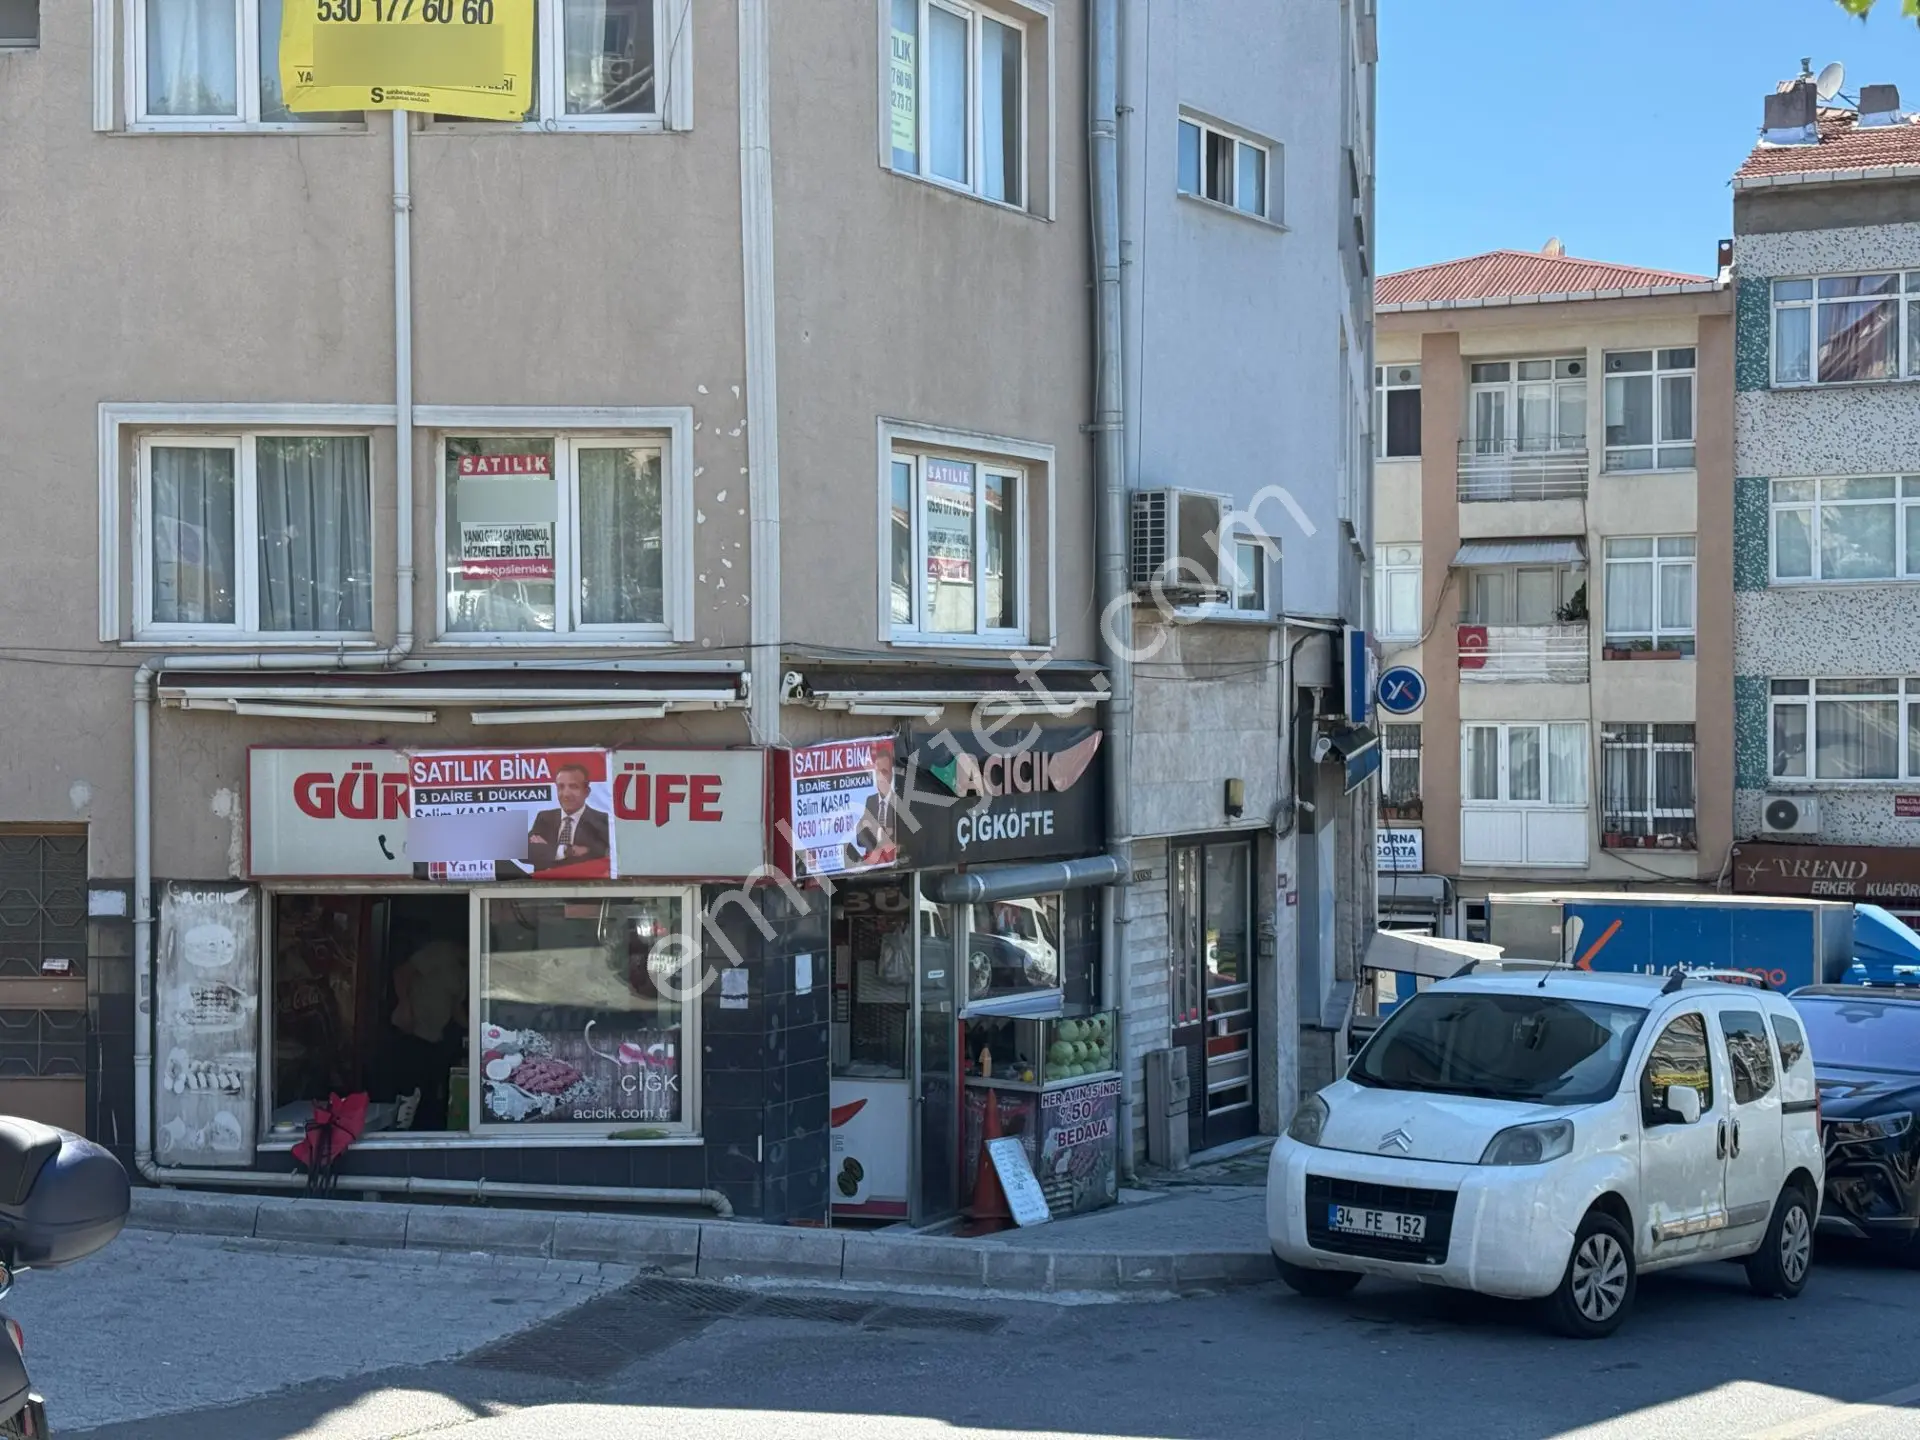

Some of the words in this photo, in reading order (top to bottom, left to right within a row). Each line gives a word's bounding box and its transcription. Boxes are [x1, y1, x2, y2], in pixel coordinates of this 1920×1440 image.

[422, 0, 453, 23] 60
[462, 0, 494, 24] 60
[463, 457, 546, 473] SATILIK
[928, 465, 969, 484] SATILIK
[414, 760, 494, 783] SATILIK
[500, 754, 551, 780] BİNA
[795, 747, 843, 773] SATILIK
[846, 743, 873, 768] BİNA
[420, 791, 428, 803] 3
[431, 789, 473, 803] DAİRE
[478, 791, 483, 802] 1
[488, 787, 548, 802] DÜKKAN
[800, 785, 804, 793] 3
[805, 780, 831, 792] DAİRE
[833, 782, 837, 790] 1
[839, 775, 873, 789] DÜKKAN
[957, 810, 1054, 851] ÇİĞKÖFTE
[1773, 858, 1868, 879] TREND
[1811, 880, 1856, 895] ERKEK
[1043, 1093, 1063, 1107] HER
[1060, 1100, 1092, 1124] %50
[1057, 1119, 1109, 1148] BEDAVA
[1336, 1207, 1354, 1226] 34
[1365, 1211, 1383, 1230] FE
[1396, 1215, 1421, 1235] 152
